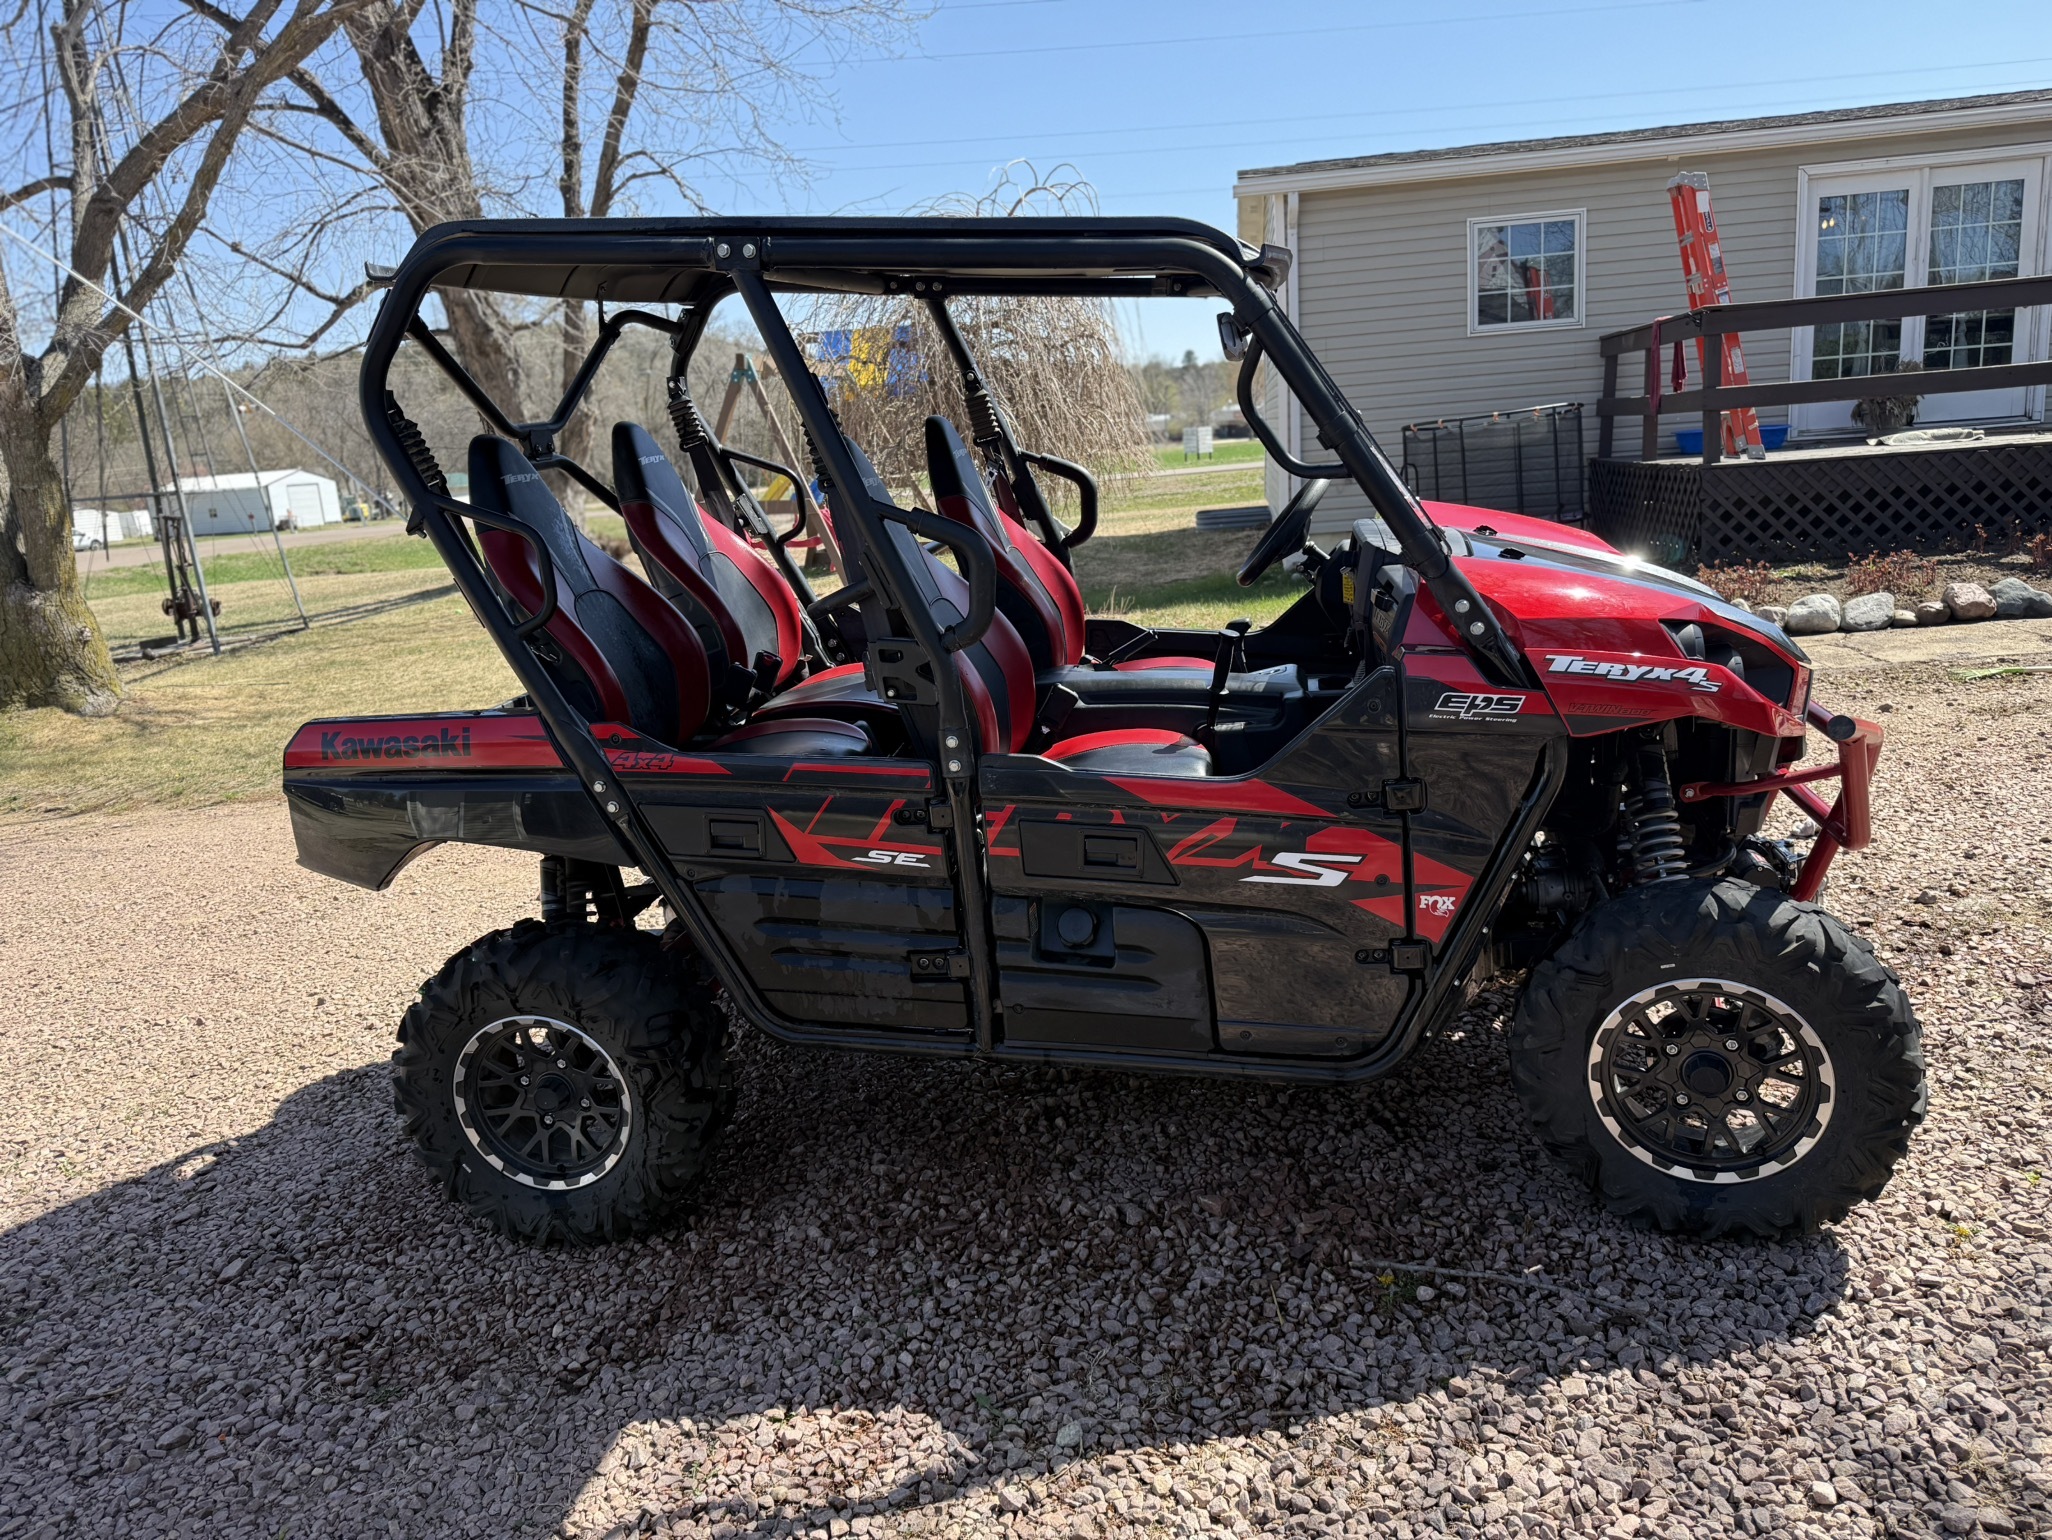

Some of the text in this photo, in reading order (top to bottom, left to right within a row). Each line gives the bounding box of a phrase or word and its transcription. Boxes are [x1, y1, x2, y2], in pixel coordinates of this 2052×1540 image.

[638, 454, 665, 466] TERYX
[500, 472, 540, 485] TERYX
[1434, 692, 1526, 716] EPS
[320, 727, 472, 760] Kawasaki
[851, 850, 931, 868] SE
[1238, 852, 1363, 887] S
[1419, 895, 1456, 917] FOX
